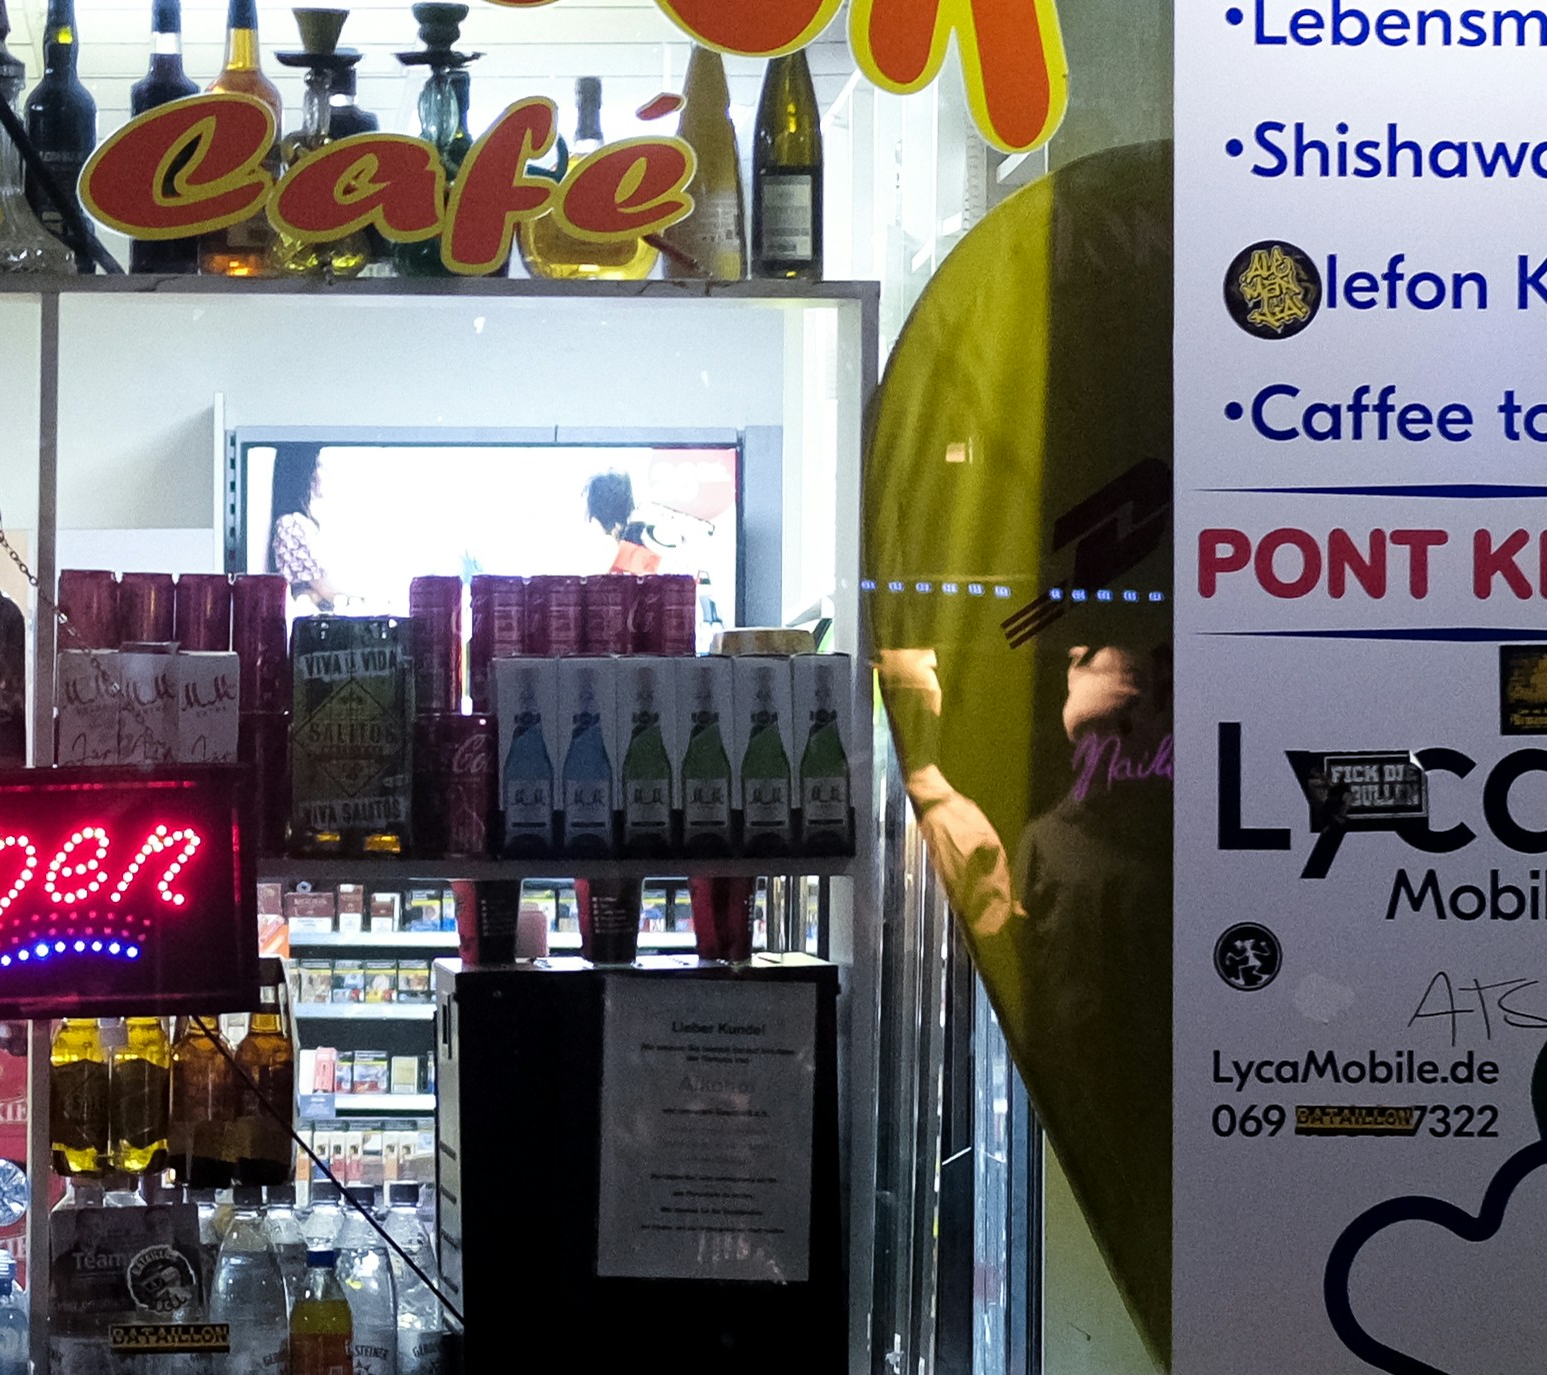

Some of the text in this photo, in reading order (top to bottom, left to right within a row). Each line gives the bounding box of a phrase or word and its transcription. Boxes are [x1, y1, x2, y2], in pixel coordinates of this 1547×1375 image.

[81, 91, 697, 276] Café
[1326, 253, 1488, 311] lefon
[1251, 383, 1473, 442] Caffee
[1197, 527, 1449, 600] PONT
[1211, 1049, 1500, 1089] LycaMobile.de
[1211, 1104, 1286, 1138] 069
[111, 1326, 229, 1345] BATAILLON
